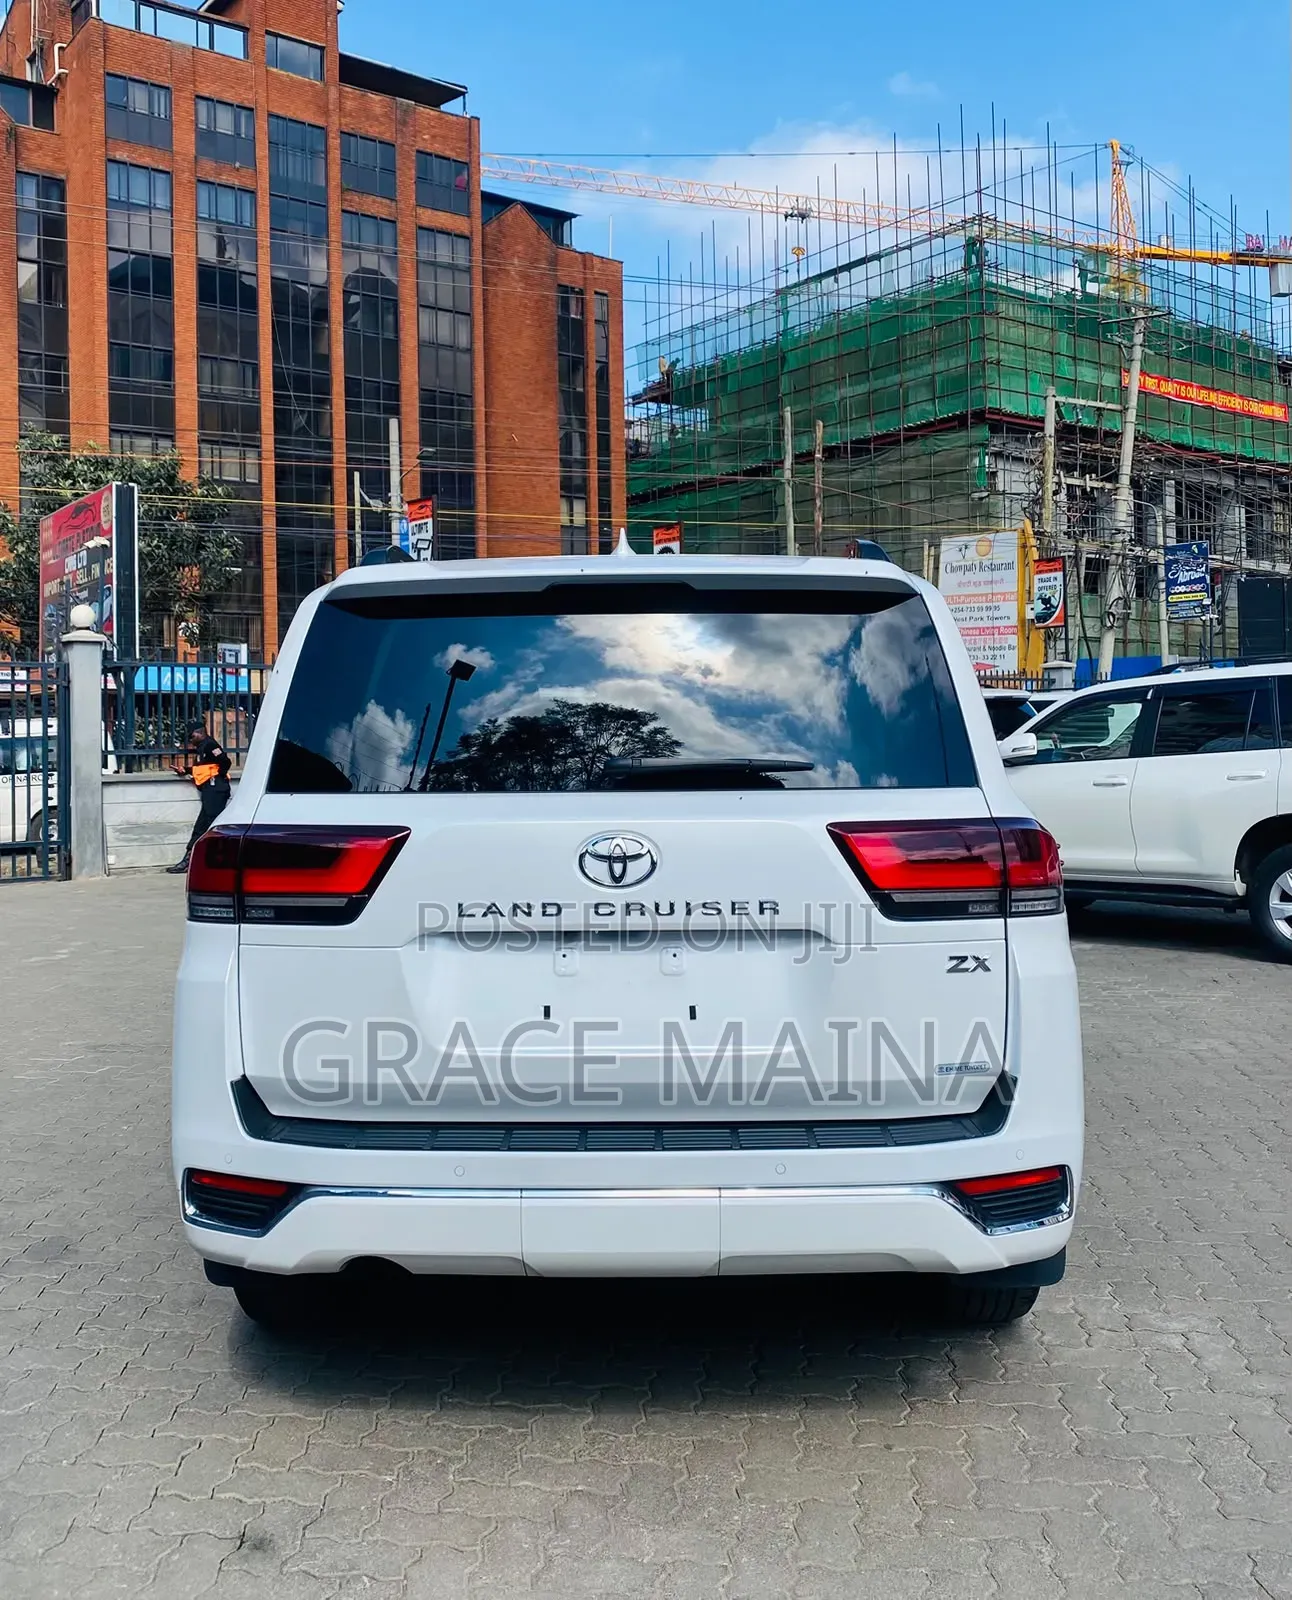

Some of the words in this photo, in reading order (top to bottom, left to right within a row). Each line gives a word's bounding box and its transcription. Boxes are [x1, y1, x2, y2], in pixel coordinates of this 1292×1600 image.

[1160, 381, 1181, 395] QUALITY
[1187, 386, 1197, 399] OUR
[944, 561, 977, 575] Chowpaty
[979, 560, 1015, 573] Restaurant
[1037, 576, 1052, 584] TRADE
[1053, 575, 1058, 583] IN
[1037, 584, 1057, 592] OFFERED
[945, 595, 986, 605] ULTI-Purpose
[987, 593, 1004, 604] Party
[986, 614, 1011, 622] Towers
[960, 627, 980, 636] hinese
[980, 626, 999, 636] Living
[999, 625, 1018, 634] Room
[988, 644, 1007, 652] Noodle
[457, 900, 563, 918] LAND
[593, 900, 781, 917] CRUISER
[946, 953, 992, 974] ZX
